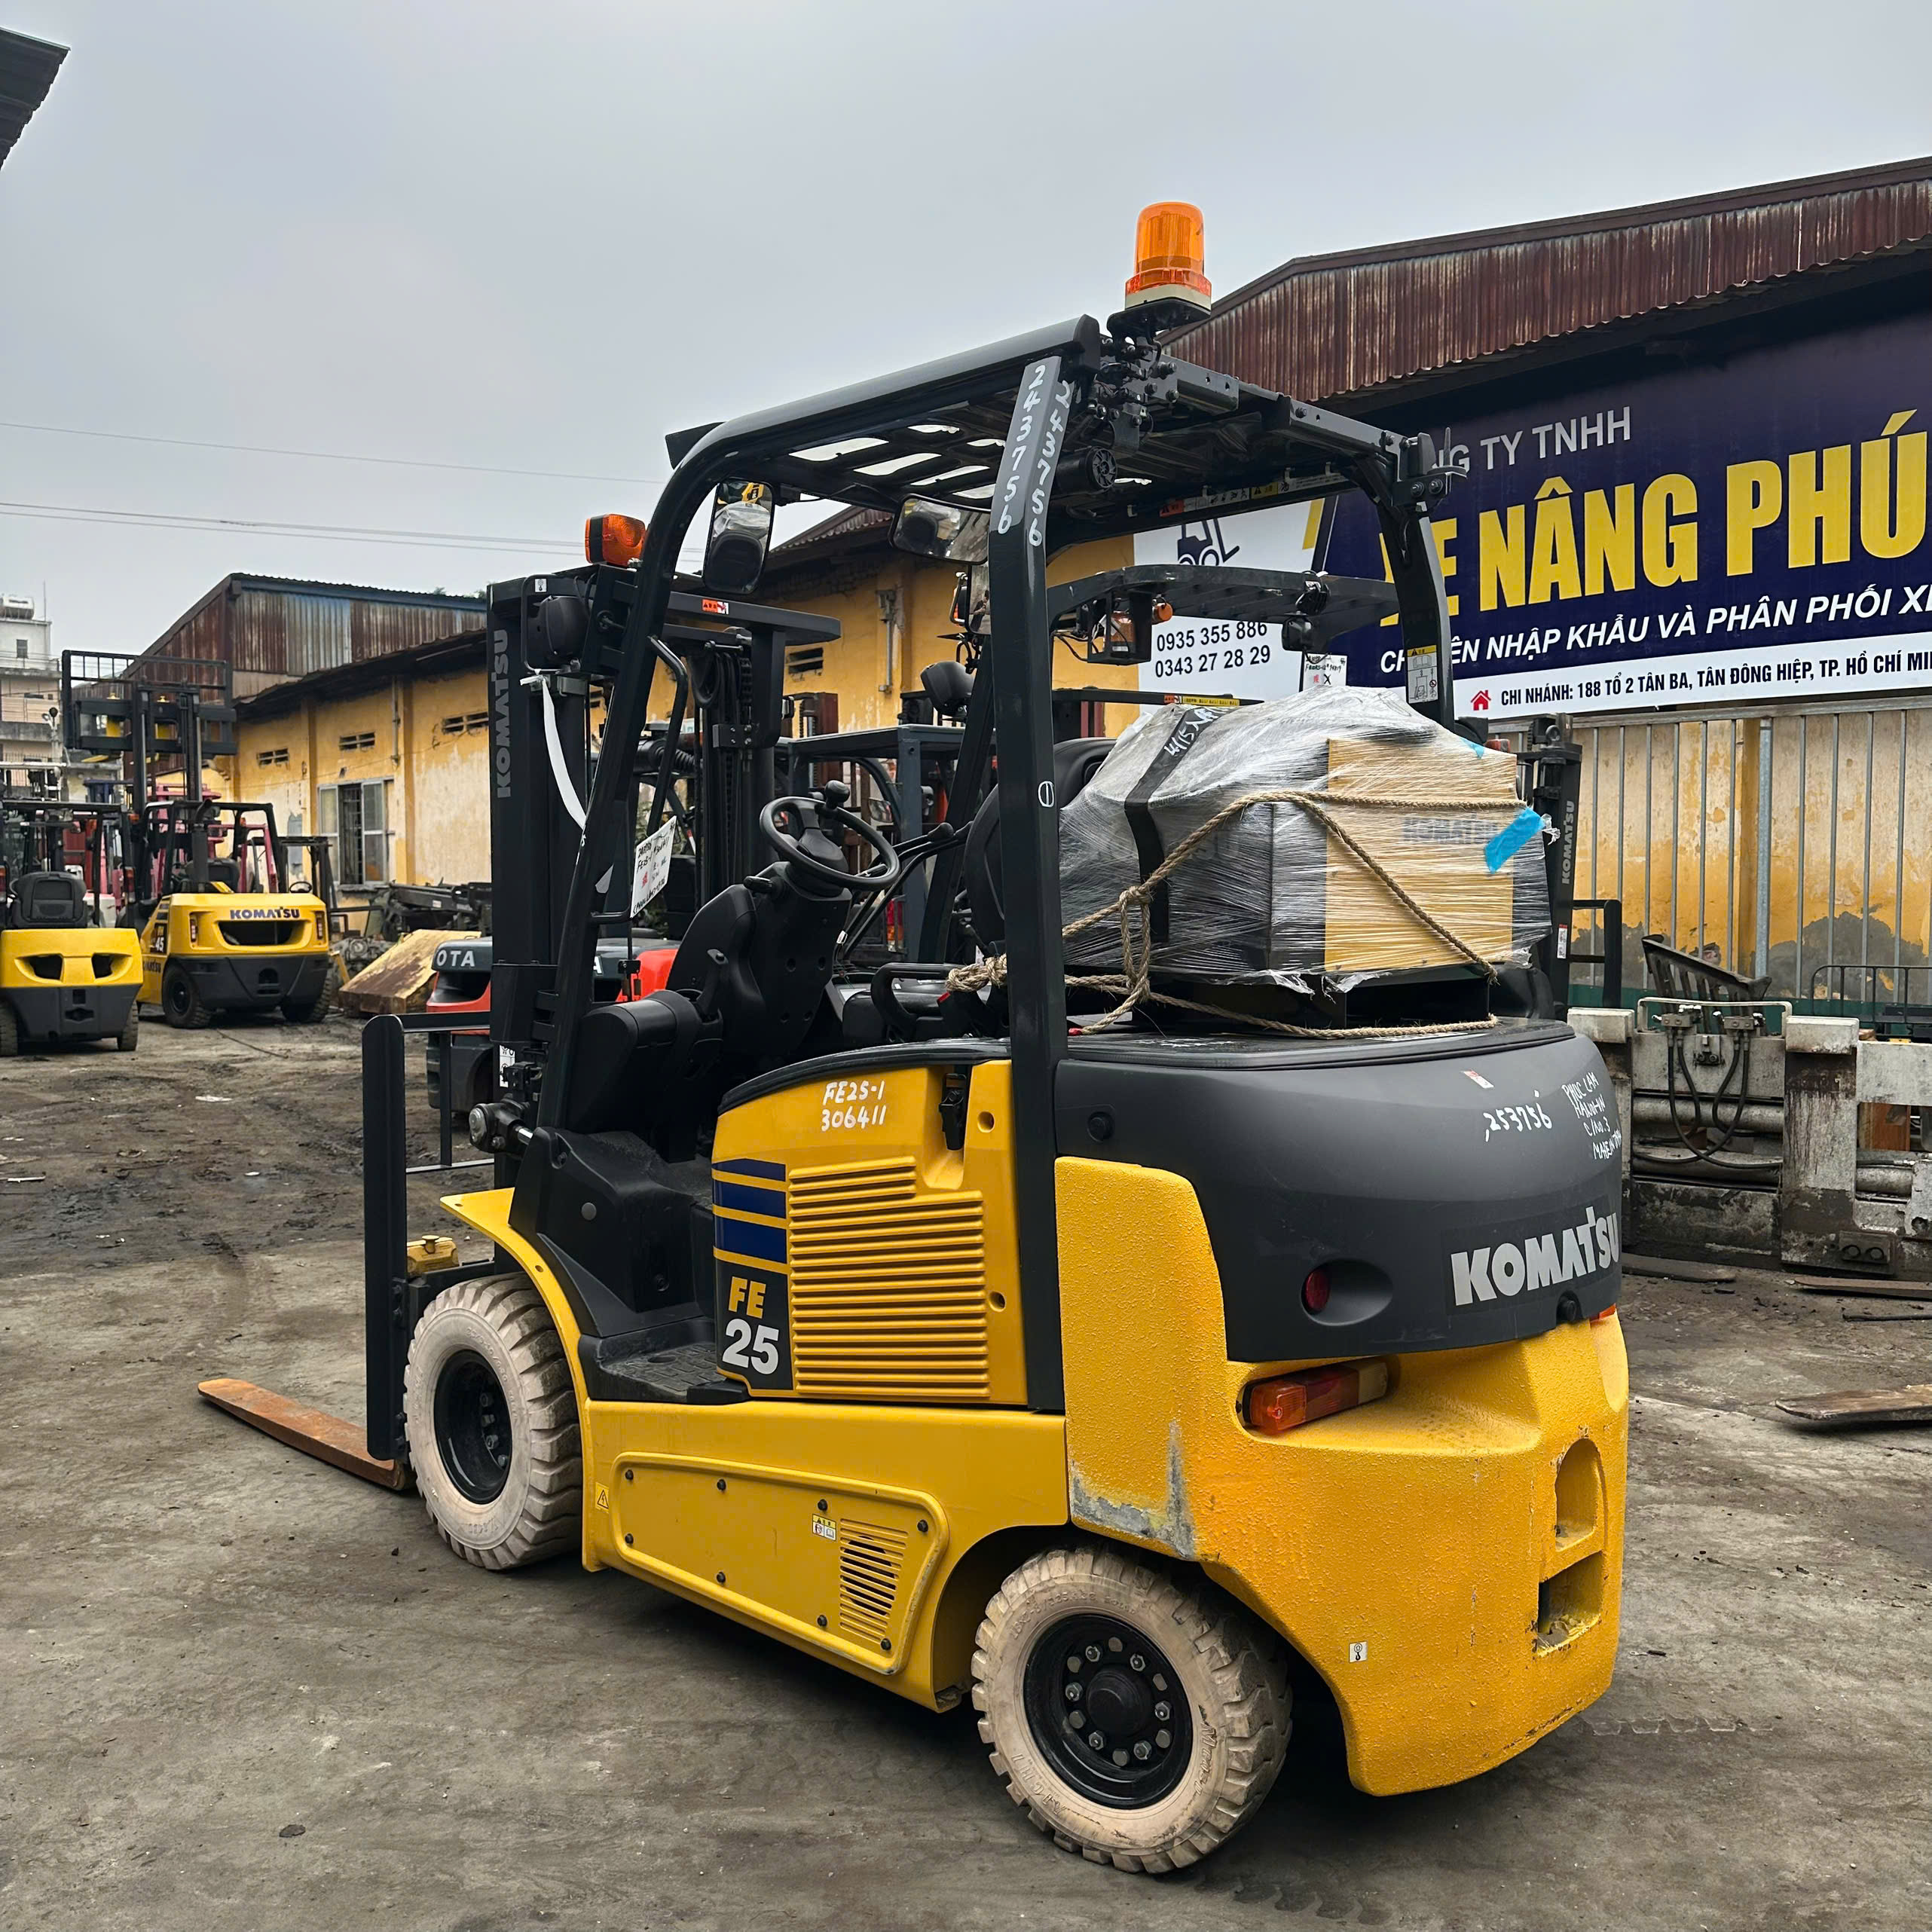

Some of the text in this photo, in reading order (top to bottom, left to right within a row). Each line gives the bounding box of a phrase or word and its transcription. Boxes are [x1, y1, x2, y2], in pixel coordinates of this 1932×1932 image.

[998, 365, 1046, 534] 243756
[1481, 431, 1523, 470] TY
[1532, 406, 1631, 459] TNHH
[1479, 474, 1698, 612] NÂNG
[1726, 408, 1927, 576] PHÚ
[1157, 630, 1194, 651] 0935
[1200, 624, 1230, 645] 355
[1485, 627, 1561, 661] NHẬP
[1567, 614, 1649, 649] KHẨU
[1658, 605, 1696, 639] VÀ
[1706, 595, 1798, 634] PHÂN
[1805, 583, 1892, 624] PHỐI
[1155, 645, 1270, 677] 0343 27 28 29
[1501, 650, 1932, 705] CHI NHÁNH: 188 TỔ 2 TÂN BA, TÂN ĐÔNG HIỆP, TP. HỒ CHÍ MI
[491, 629, 511, 798] KOMATSU
[1561, 800, 1575, 885] KOMATSU
[230, 906, 300, 919] KOMATSU
[437, 949, 475, 967] OTA
[821, 1105, 886, 1131] 306411
[822, 1080, 885, 1105] FE25-1
[1451, 1206, 1619, 1306] KOMATSU
[728, 1276, 766, 1319] FE
[722, 1318, 779, 1374] 25
